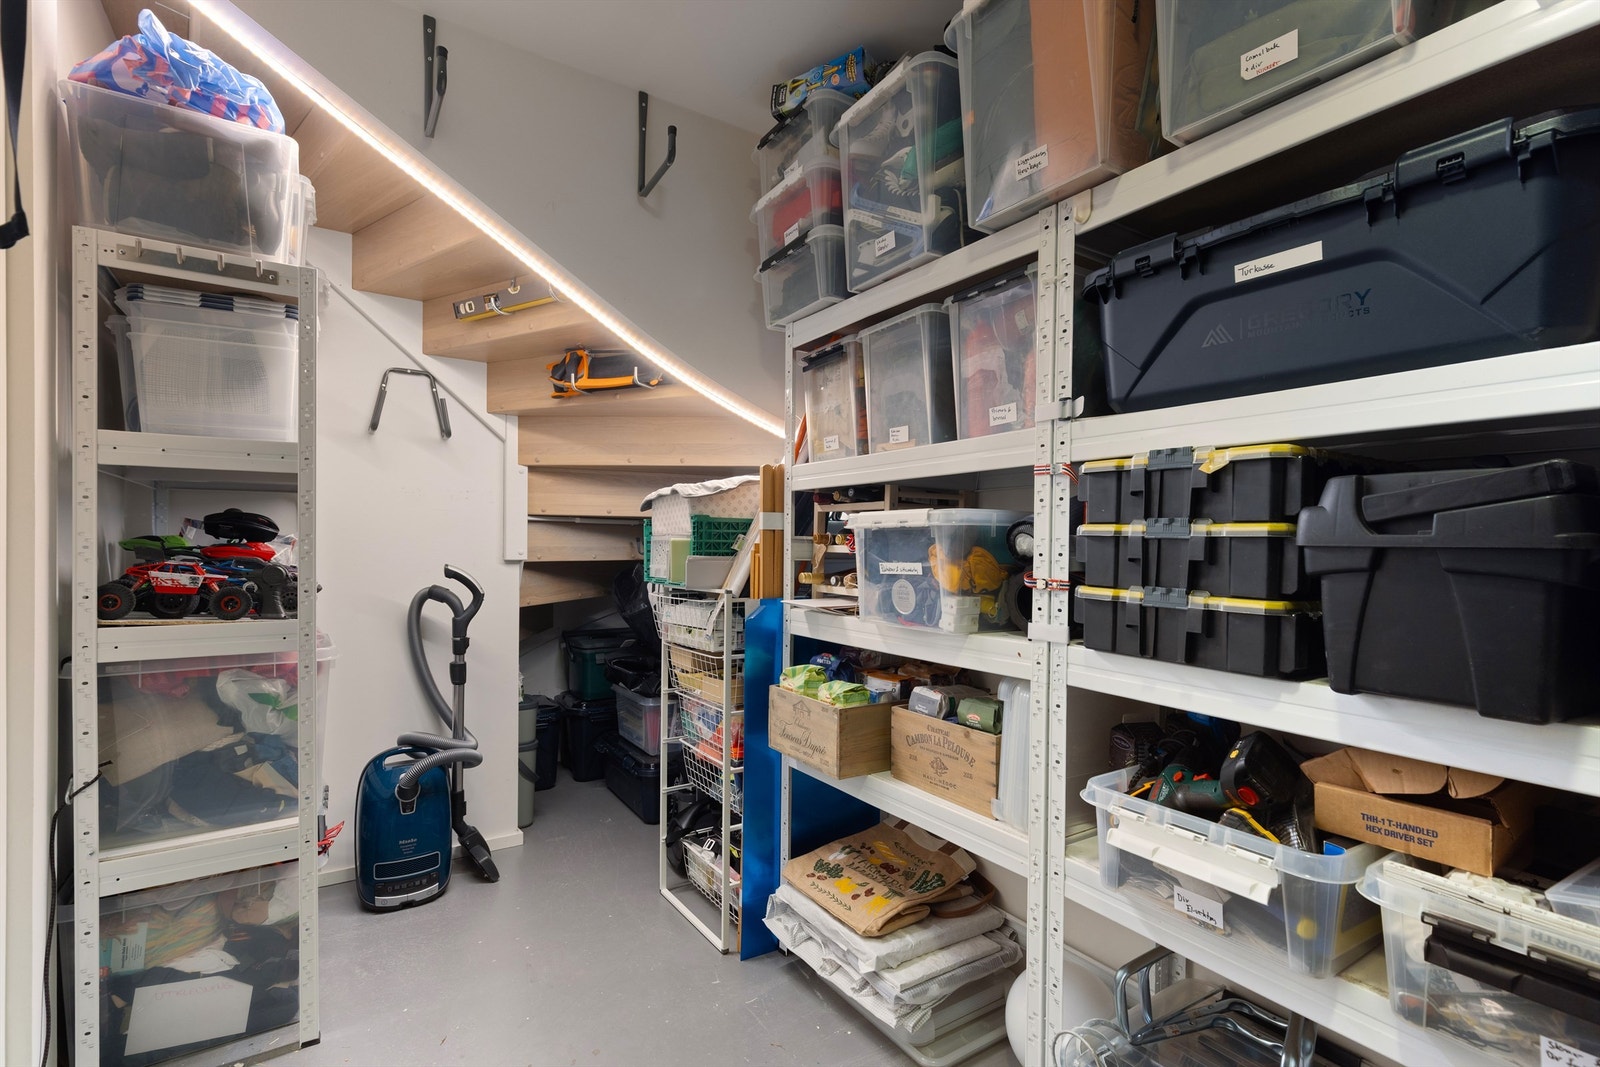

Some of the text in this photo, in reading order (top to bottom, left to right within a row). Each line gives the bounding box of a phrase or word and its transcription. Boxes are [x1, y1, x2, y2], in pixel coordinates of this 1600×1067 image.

[1237, 263, 1275, 276] Turkasse
[905, 733, 976, 768] CAMBON LA PELOUSE
[1360, 812, 1439, 839] THH-1 T-HANDLED
[1365, 824, 1435, 848] HEX DRIVER SET
